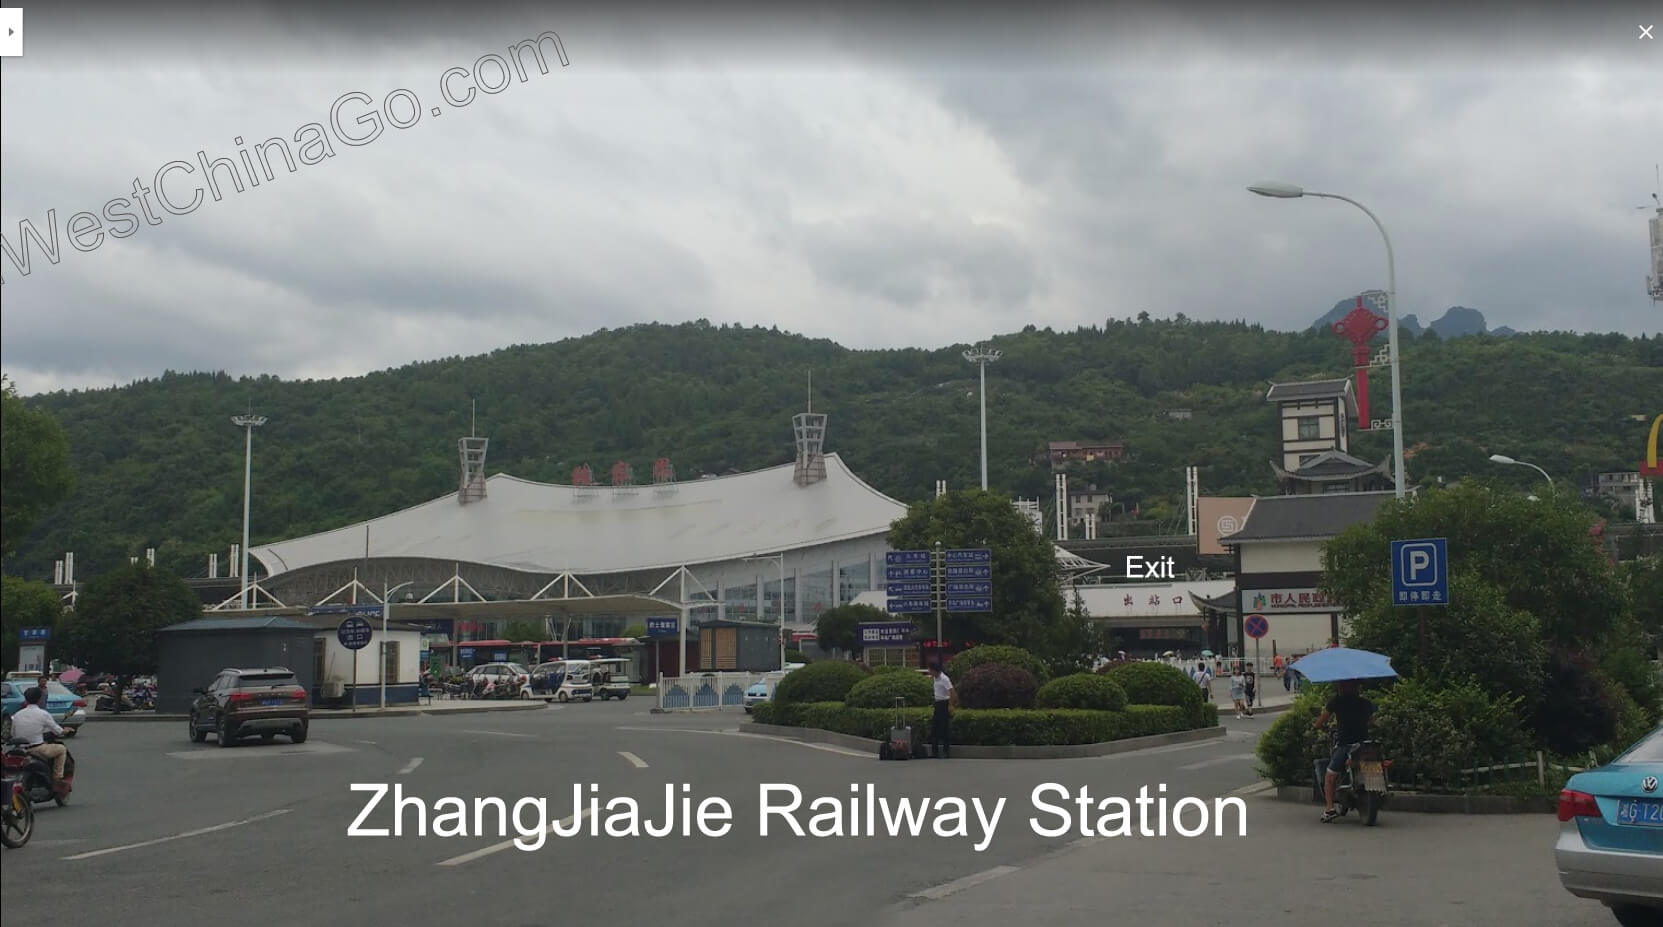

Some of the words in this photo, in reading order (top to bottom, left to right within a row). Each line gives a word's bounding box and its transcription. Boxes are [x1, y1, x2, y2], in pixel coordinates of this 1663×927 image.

[1410, 550, 1430, 580] P
[1123, 593, 1183, 606] 出站口
[1271, 592, 1338, 604] 市人民政
